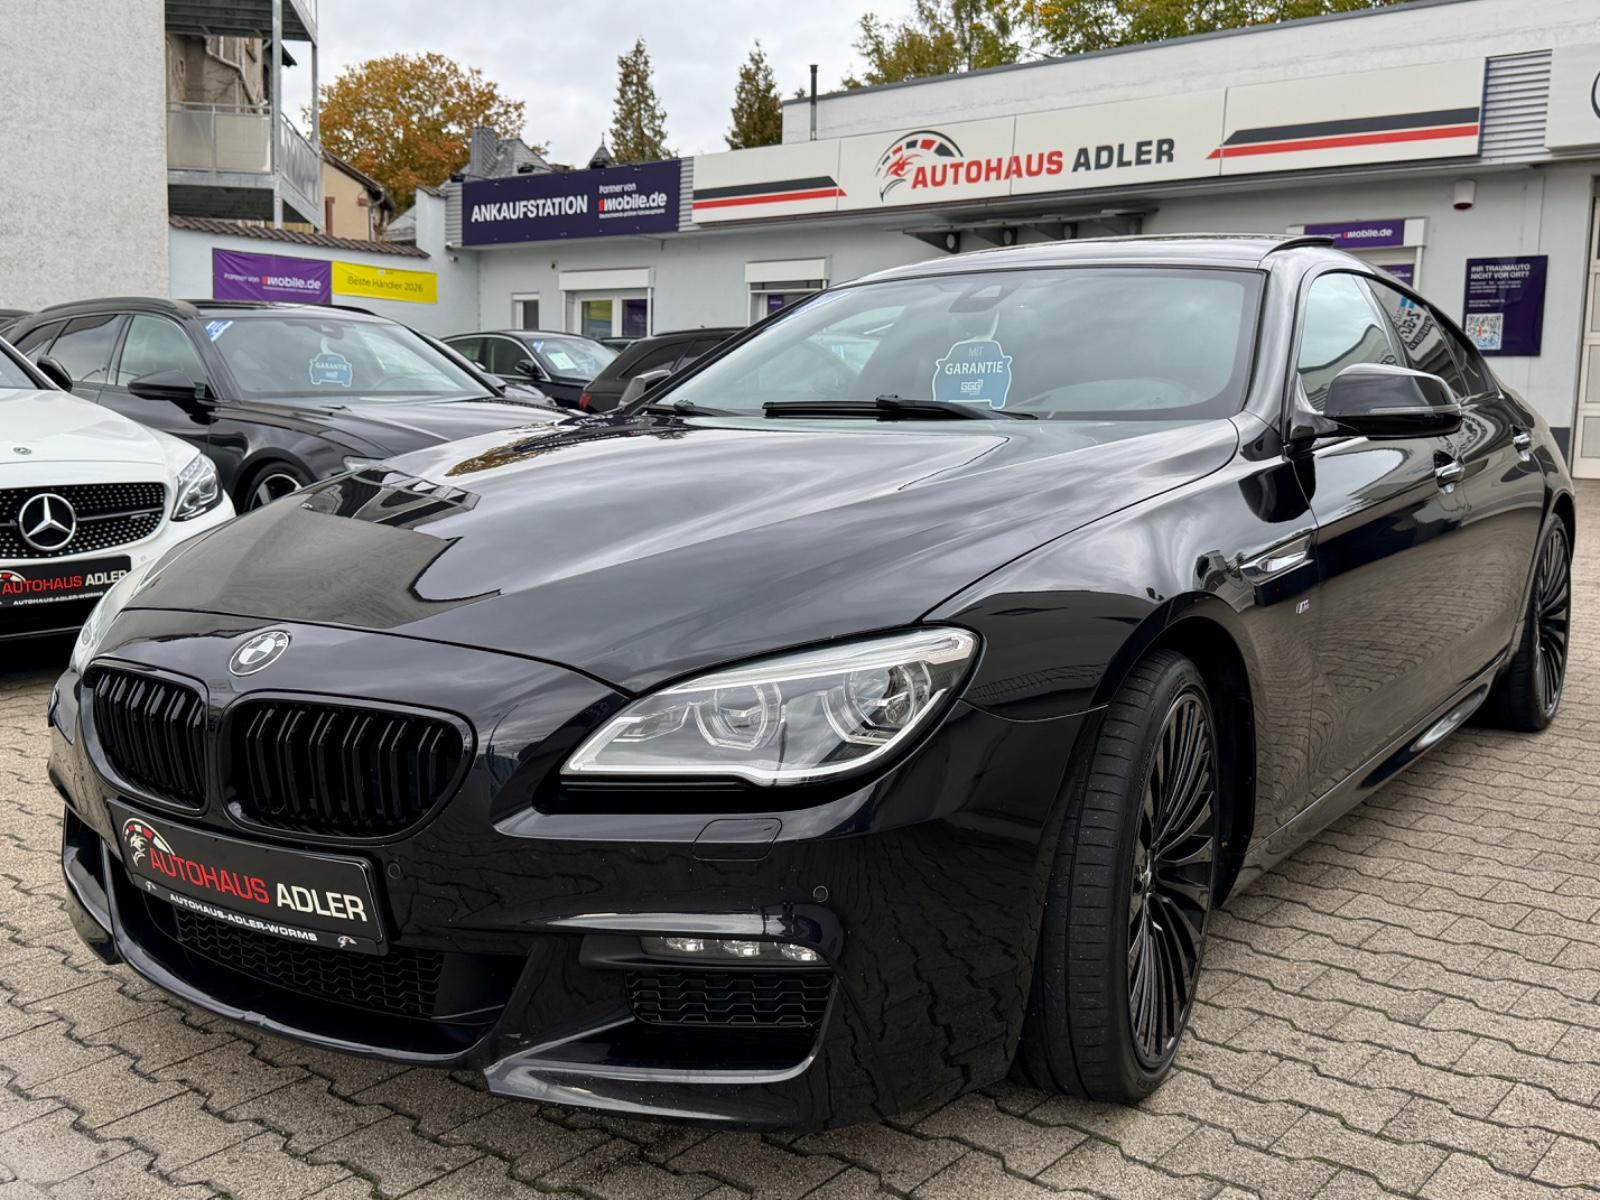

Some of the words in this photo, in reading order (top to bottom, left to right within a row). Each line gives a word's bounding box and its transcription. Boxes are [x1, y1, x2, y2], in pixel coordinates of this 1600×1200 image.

[911, 150, 1064, 190] AUTOHAUS
[1071, 138, 1176, 173] ADLER
[598, 184, 622, 195] Partner
[623, 182, 637, 192] von
[471, 194, 588, 223] ANKAUFSTATION
[598, 191, 668, 212] mobile.de
[1343, 227, 1393, 240] mobile.de
[1470, 265, 1483, 273] IHR
[1485, 263, 1531, 272] TRAUMAUTO
[1470, 272, 1492, 280] NICHT
[1493, 271, 1509, 279] VOR
[262, 275, 322, 290] mobile.de
[348, 275, 371, 288] Beste
[372, 278, 402, 290] Händler
[403, 281, 424, 293] 2026
[968, 346, 985, 357] MIT
[944, 361, 1004, 375] GARANTIE
[2, 575, 82, 595] AUTOHAUS
[149, 848, 270, 905] AUTOHAUS
[276, 882, 368, 922] ADLER
[169, 893, 318, 942] AUTOHAUS-ADLER-WORMS
